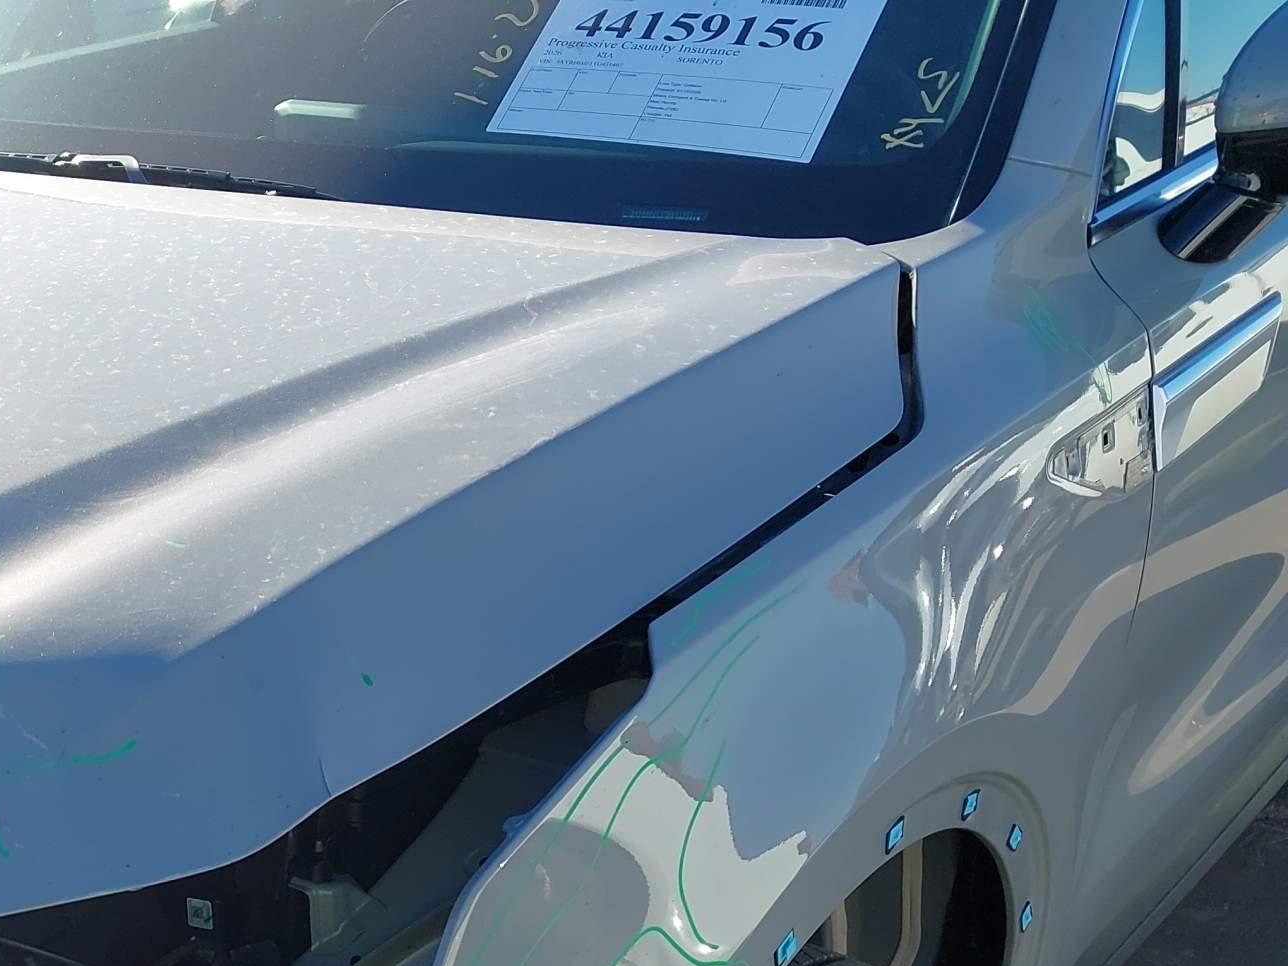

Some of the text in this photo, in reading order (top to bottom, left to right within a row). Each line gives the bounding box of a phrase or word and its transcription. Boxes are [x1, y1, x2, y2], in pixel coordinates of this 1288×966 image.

[575, 9, 833, 51] 44159156
[548, 38, 741, 58] Progressive Casualty Insurance
[676, 56, 724, 66] SORENTO
